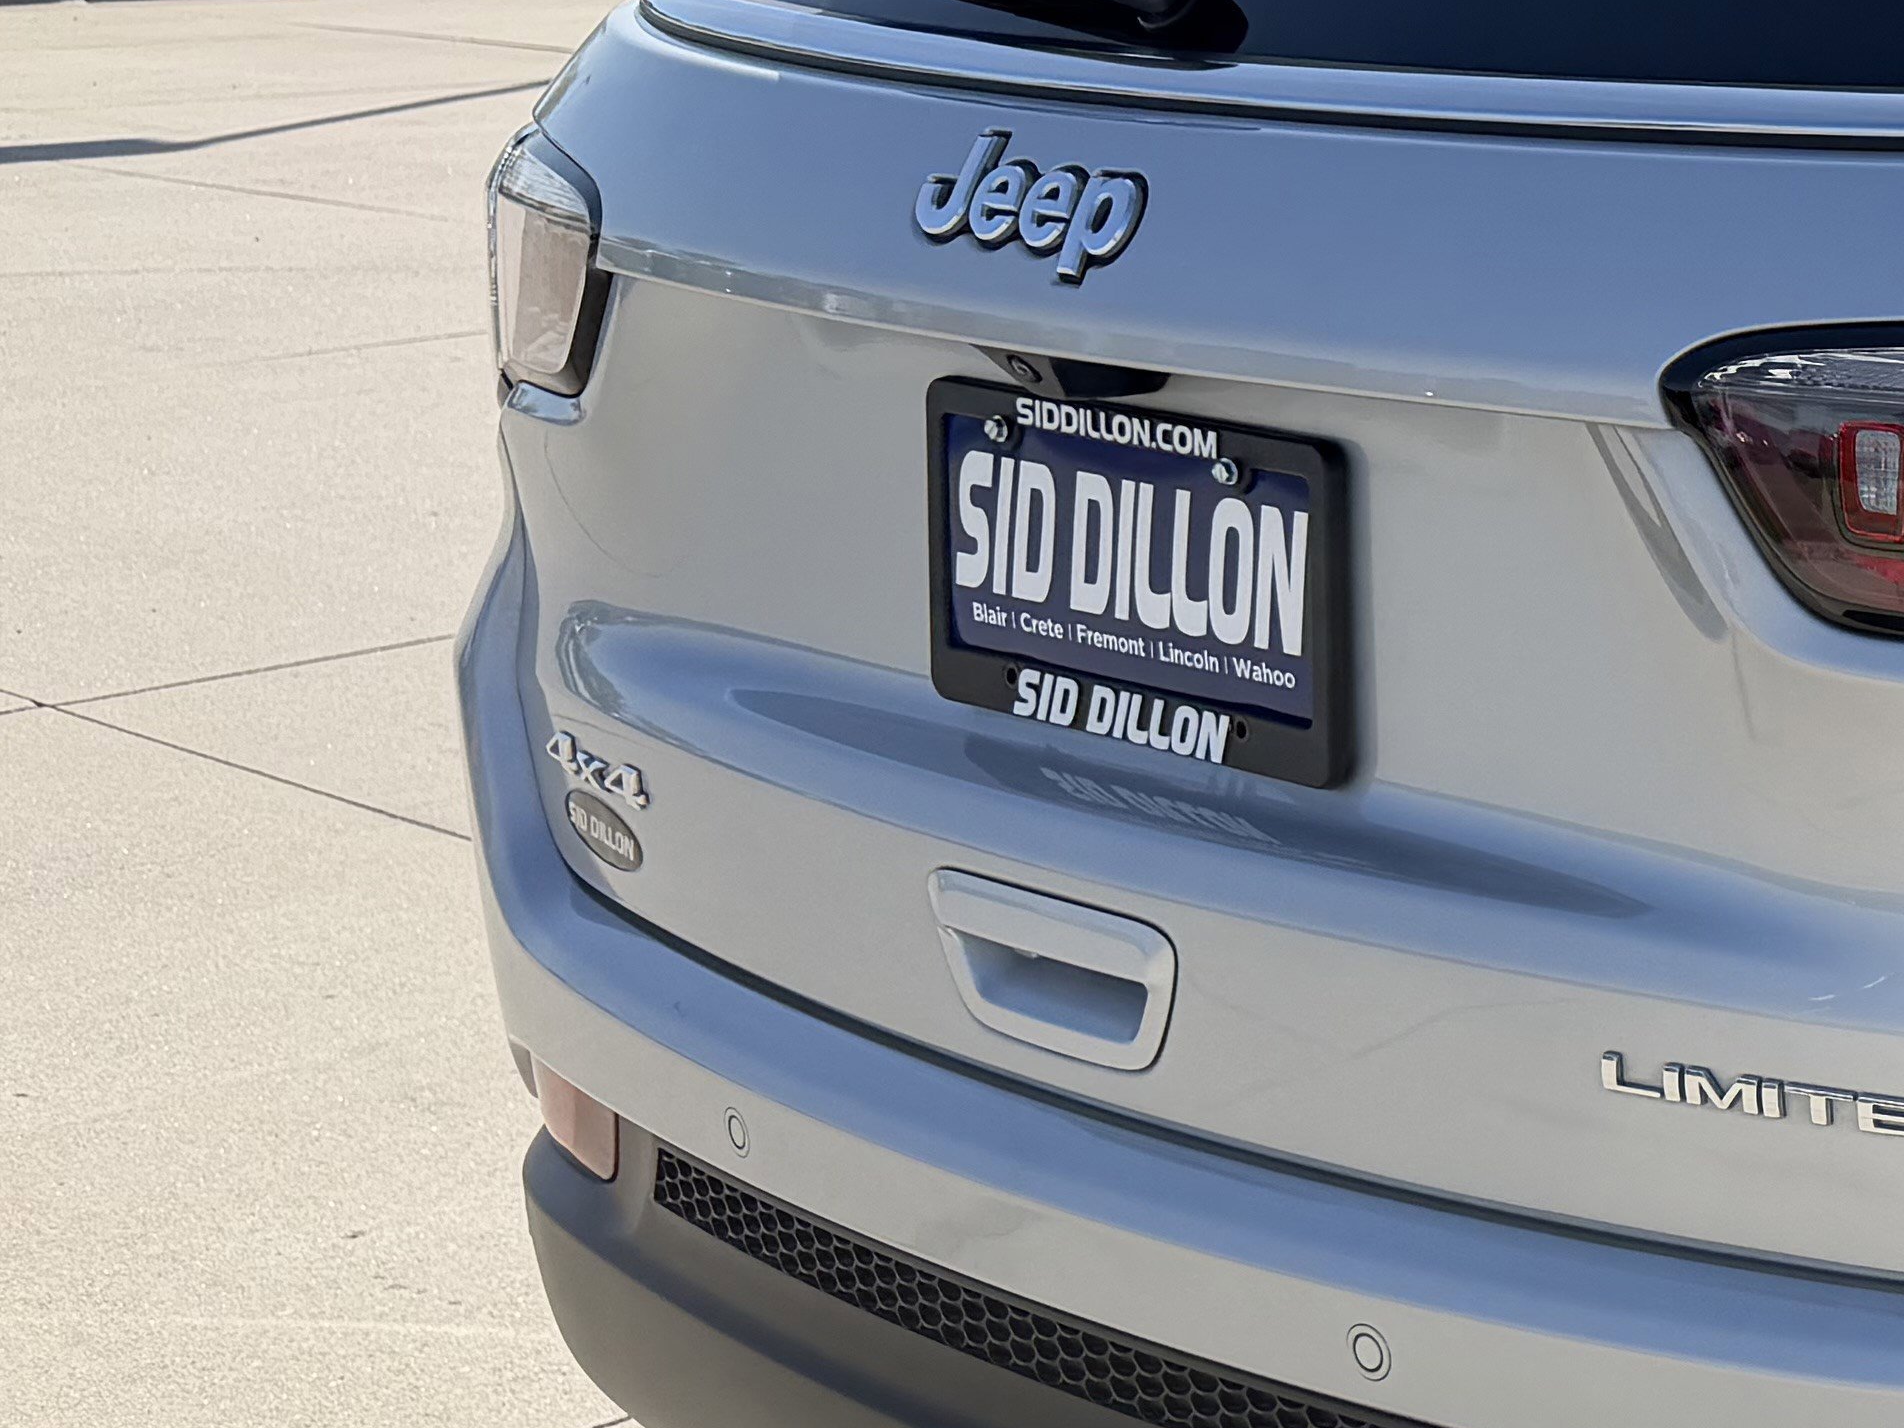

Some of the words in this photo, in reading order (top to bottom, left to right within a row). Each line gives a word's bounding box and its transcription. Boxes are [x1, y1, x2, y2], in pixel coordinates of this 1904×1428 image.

[915, 128, 1149, 286] Jeep
[1016, 397, 1218, 459] SIDDILLON.COM
[956, 450, 1056, 603] SID
[1070, 471, 1308, 656] DILLON
[972, 601, 1008, 628] Blair
[1020, 613, 1064, 639] Crete
[1076, 624, 1146, 657] Fremont
[1158, 641, 1219, 673] Lincoln
[1233, 657, 1296, 689] Wahoo
[1013, 668, 1079, 726] SID
[1086, 684, 1230, 763] DILLON
[569, 801, 588, 832] SID
